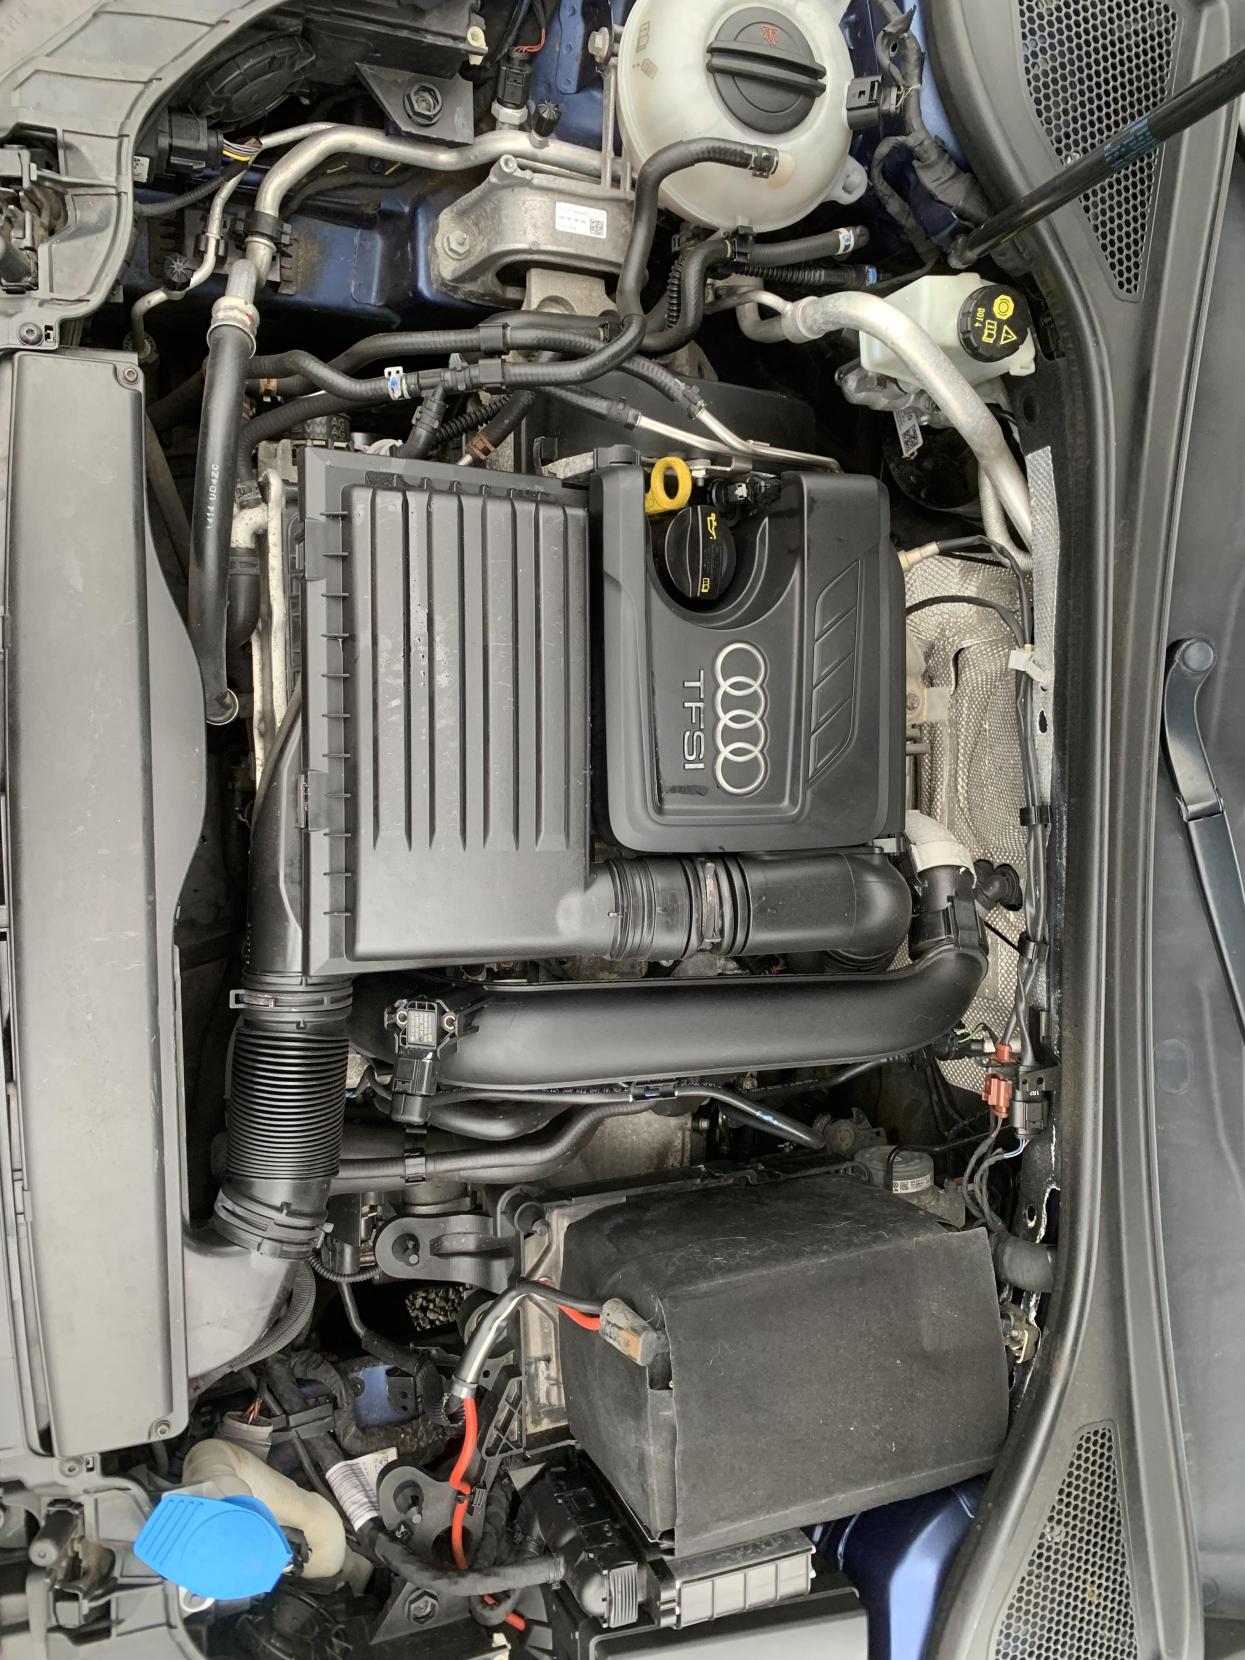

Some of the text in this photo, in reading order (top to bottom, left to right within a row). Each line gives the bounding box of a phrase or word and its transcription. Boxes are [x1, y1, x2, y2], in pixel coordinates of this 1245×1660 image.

[976, 307, 985, 321] DOT
[331, 416, 345, 427] AG
[304, 424, 327, 434] VW
[683, 669, 705, 770] TFSI
